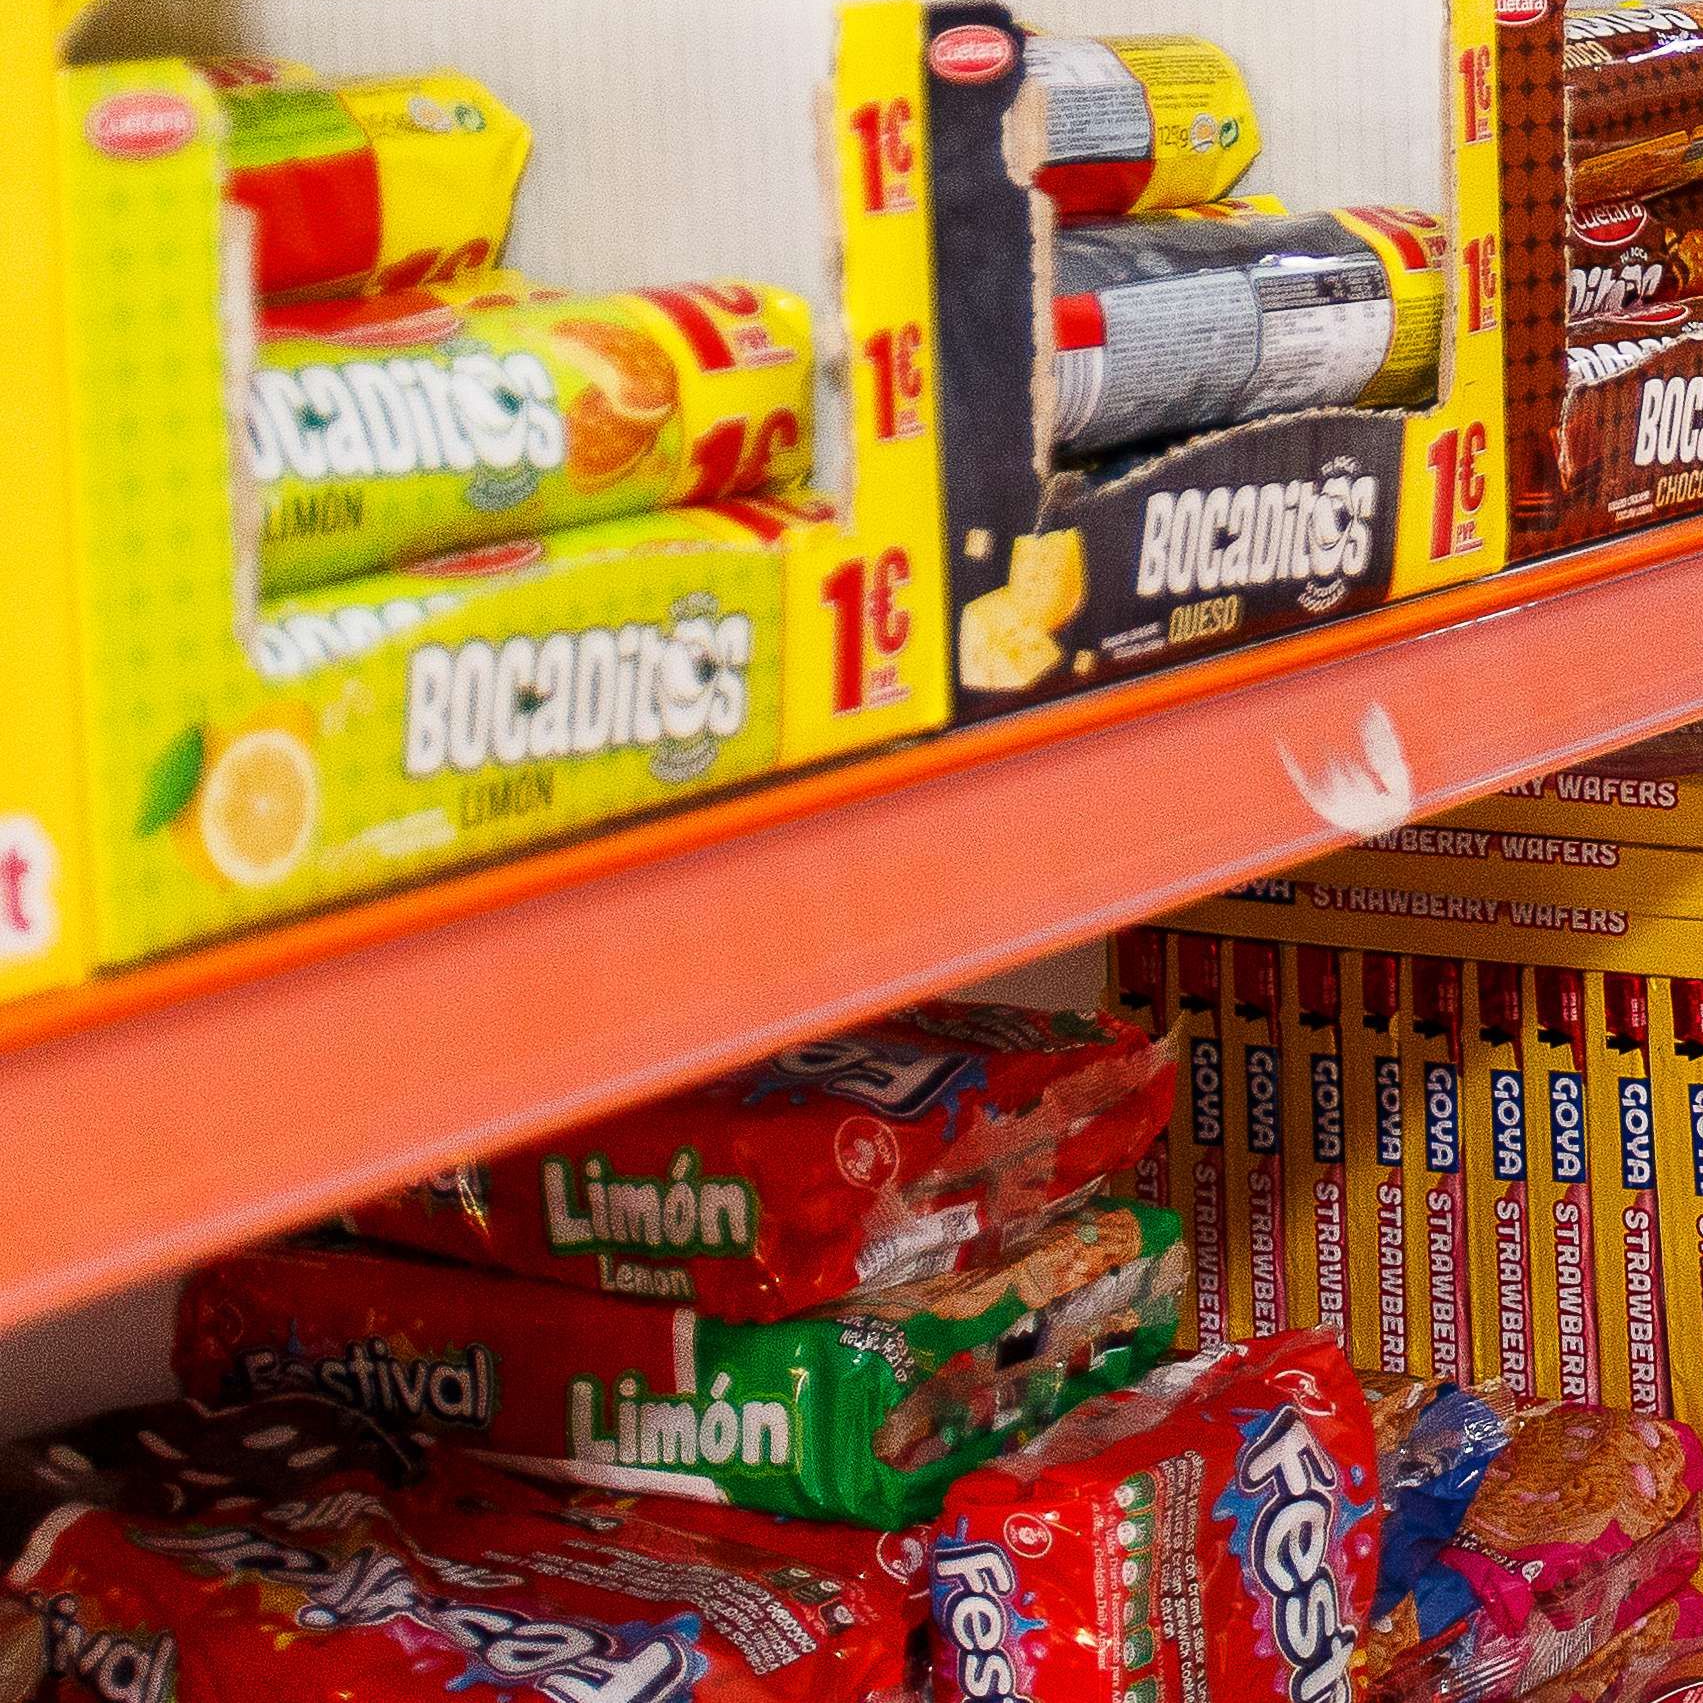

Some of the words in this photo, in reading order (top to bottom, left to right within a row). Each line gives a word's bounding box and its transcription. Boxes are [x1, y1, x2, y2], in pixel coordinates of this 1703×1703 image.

[1458, 46, 1492, 144] 1€
[1465, 234, 1498, 334] 1€
[1426, 420, 1486, 562] 1€
[821, 546, 912, 715] 1€
[1166, 597, 1244, 646] QUESO
[1555, 772, 1679, 809] WAFERS
[1500, 835, 1619, 866] WAFERS
[1311, 880, 1498, 924] STRAWBERRY
[1508, 900, 1629, 935] WAFERS
[1249, 1047, 1276, 1150] GOYA
[1314, 1056, 1341, 1159] GOYA
[1377, 1061, 1402, 1164] GOYA
[1428, 1066, 1456, 1170] GOYA
[1495, 1073, 1524, 1177] GOYA
[1553, 1076, 1583, 1180] GOYA
[1622, 1082, 1652, 1187] GOYA
[542, 1146, 752, 1247] Limón
[598, 1255, 690, 1297] Lemon
[570, 1372, 791, 1465] Limón
